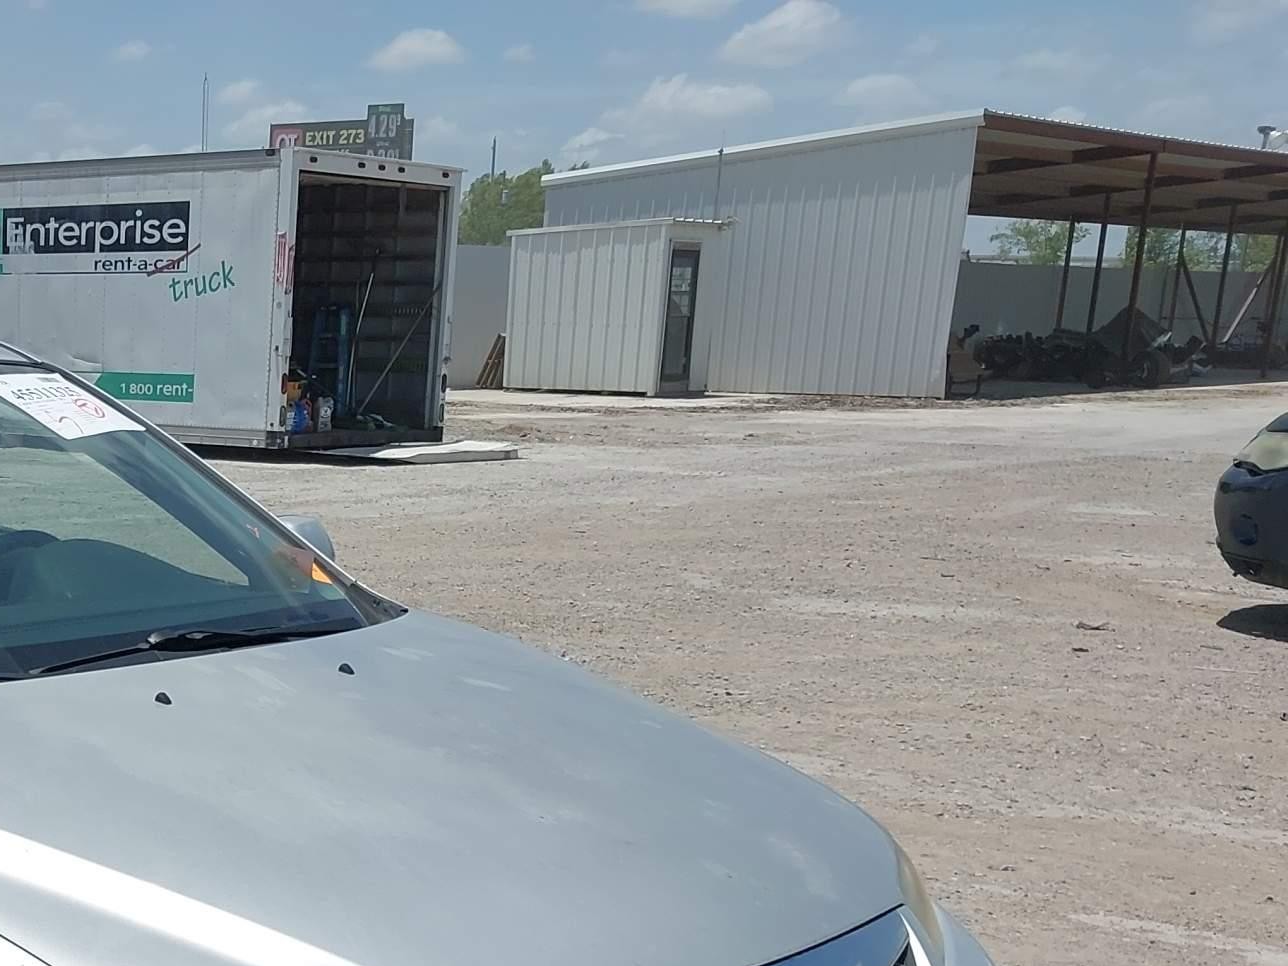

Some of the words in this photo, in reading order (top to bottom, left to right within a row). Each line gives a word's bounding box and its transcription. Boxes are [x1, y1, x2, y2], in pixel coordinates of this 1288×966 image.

[305, 130, 336, 146] EXIT
[339, 129, 365, 145] 273
[6, 209, 187, 254] Enterprise
[94, 253, 185, 272] rent-a-car
[169, 261, 236, 302] truck
[11, 386, 83, 402] 45511325
[120, 383, 127, 394] 1
[129, 383, 154, 396] 800
[156, 381, 194, 397] rent-
